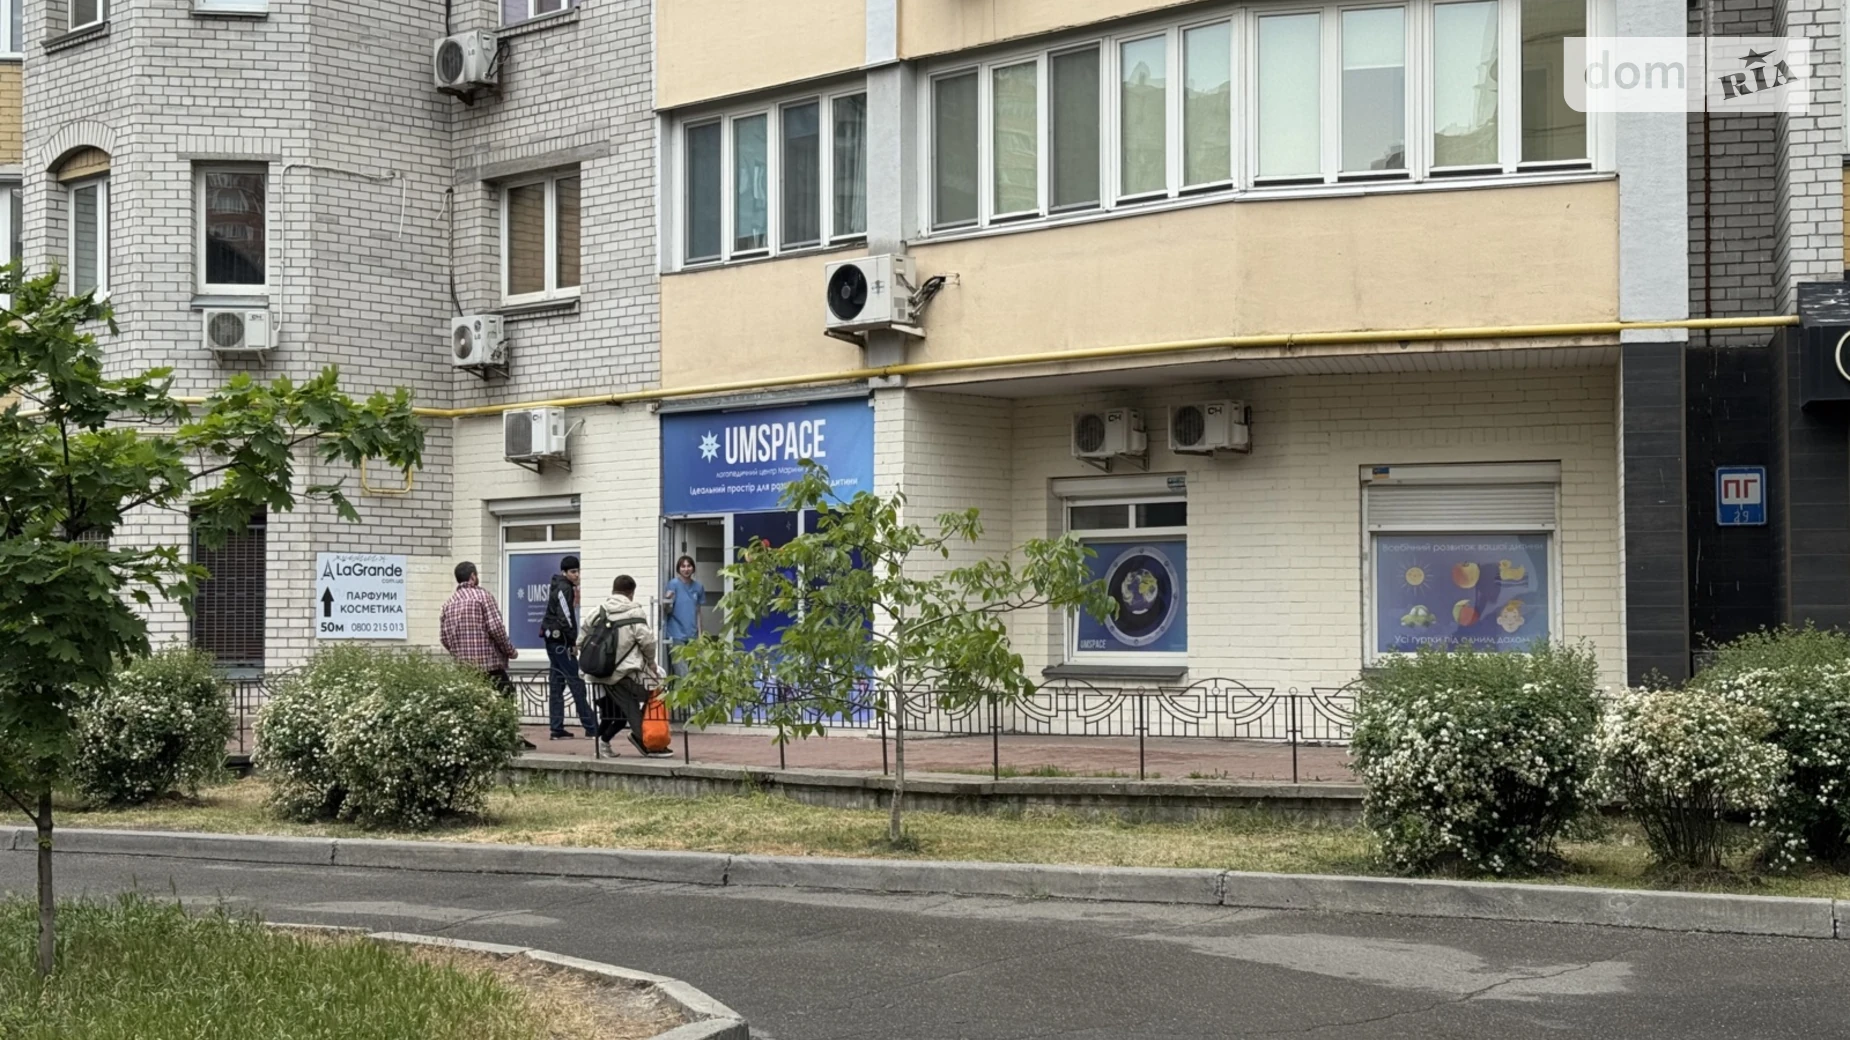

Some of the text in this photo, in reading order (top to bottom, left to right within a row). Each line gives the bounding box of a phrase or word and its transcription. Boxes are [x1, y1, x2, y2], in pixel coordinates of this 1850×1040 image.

[725, 419, 826, 465] UMSPACE
[690, 484, 726, 496] Ідеальний
[727, 482, 755, 495] простір
[756, 483, 770, 493] для
[830, 478, 858, 487] дитини
[1724, 479, 1758, 499] ПГ
[336, 562, 403, 577] LaGrande
[346, 591, 398, 601] ПАРФУМИ
[340, 604, 403, 614] КОСМЕТИКА
[351, 622, 372, 632] 0800
[373, 622, 388, 632] 215
[389, 622, 404, 632] 013
[1080, 639, 1106, 649] UMSPACE
[1394, 635, 1409, 644] Усі
